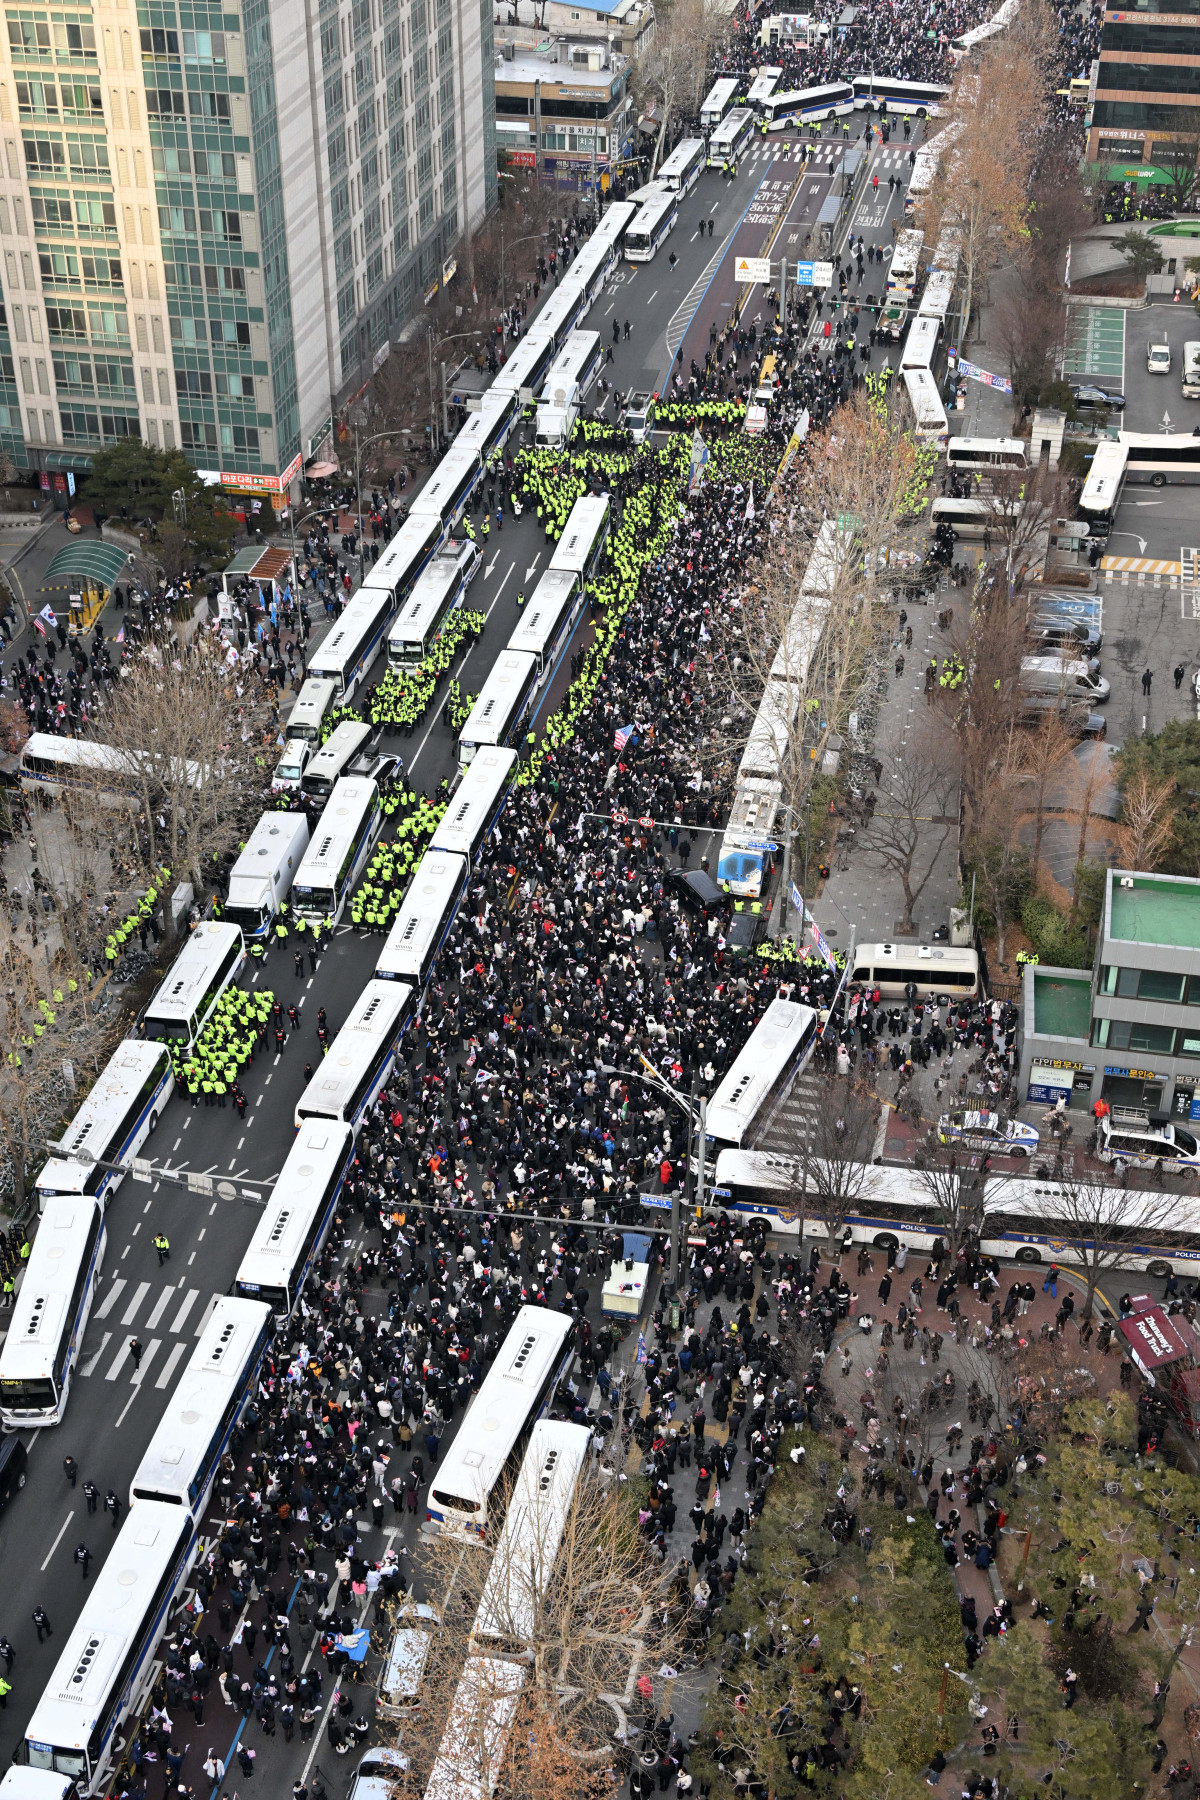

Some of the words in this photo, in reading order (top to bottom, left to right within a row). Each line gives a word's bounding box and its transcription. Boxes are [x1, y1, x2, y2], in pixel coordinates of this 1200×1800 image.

[560, 126, 593, 135] 서울치과
[1124, 170, 1155, 178] SUBWAY
[222, 474, 253, 485] 마포다리
[1175, 1251, 1200, 1259] POLICE
[1136, 1320, 1152, 1339] Food
[1147, 1336, 1164, 1357] Truck
